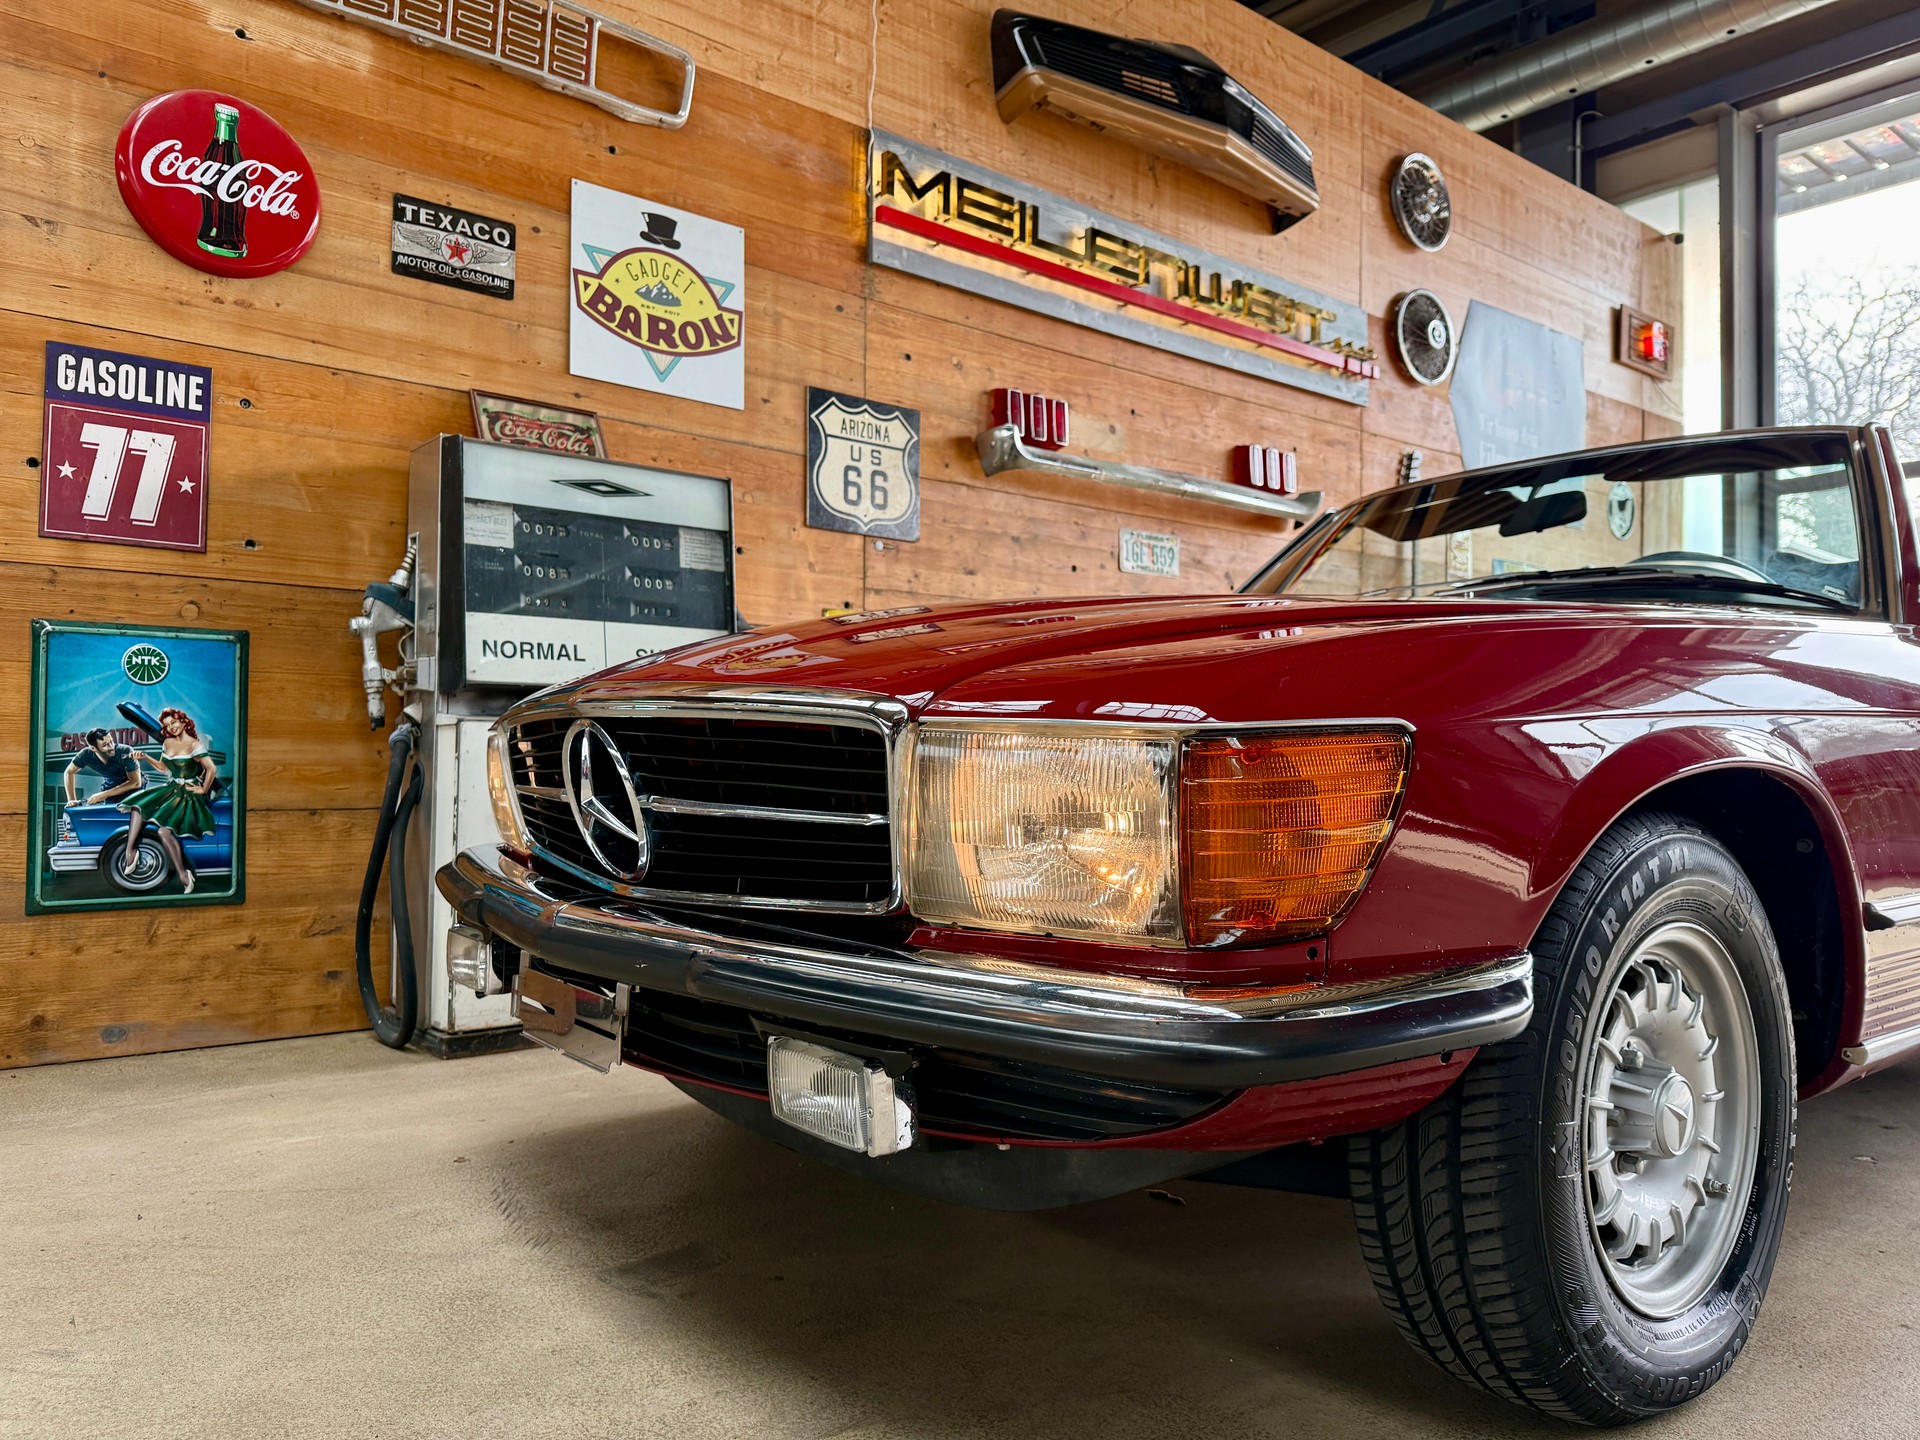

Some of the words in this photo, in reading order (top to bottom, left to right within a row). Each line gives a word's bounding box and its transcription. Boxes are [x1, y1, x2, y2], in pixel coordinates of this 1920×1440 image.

[141, 139, 303, 217] Coca-Cola
[398, 203, 510, 247] TEXACO
[398, 255, 436, 271] MOTOR
[438, 264, 454, 276] OIL
[462, 269, 510, 289] GASOLINE
[625, 258, 696, 294] GADGET
[583, 281, 736, 351] BARON
[57, 353, 204, 412] GASOLINE
[494, 419, 589, 454] Coca-Cola
[840, 418, 891, 443] ARIZONA
[79, 422, 177, 527] 77
[843, 464, 888, 511] 66
[131, 655, 161, 666] NTK
[482, 639, 587, 662] NORMAL
[1555, 943, 1603, 1108] 205/70
[1600, 907, 1621, 945] R
[1620, 870, 1646, 912] 14
[1647, 855, 1662, 884] T
